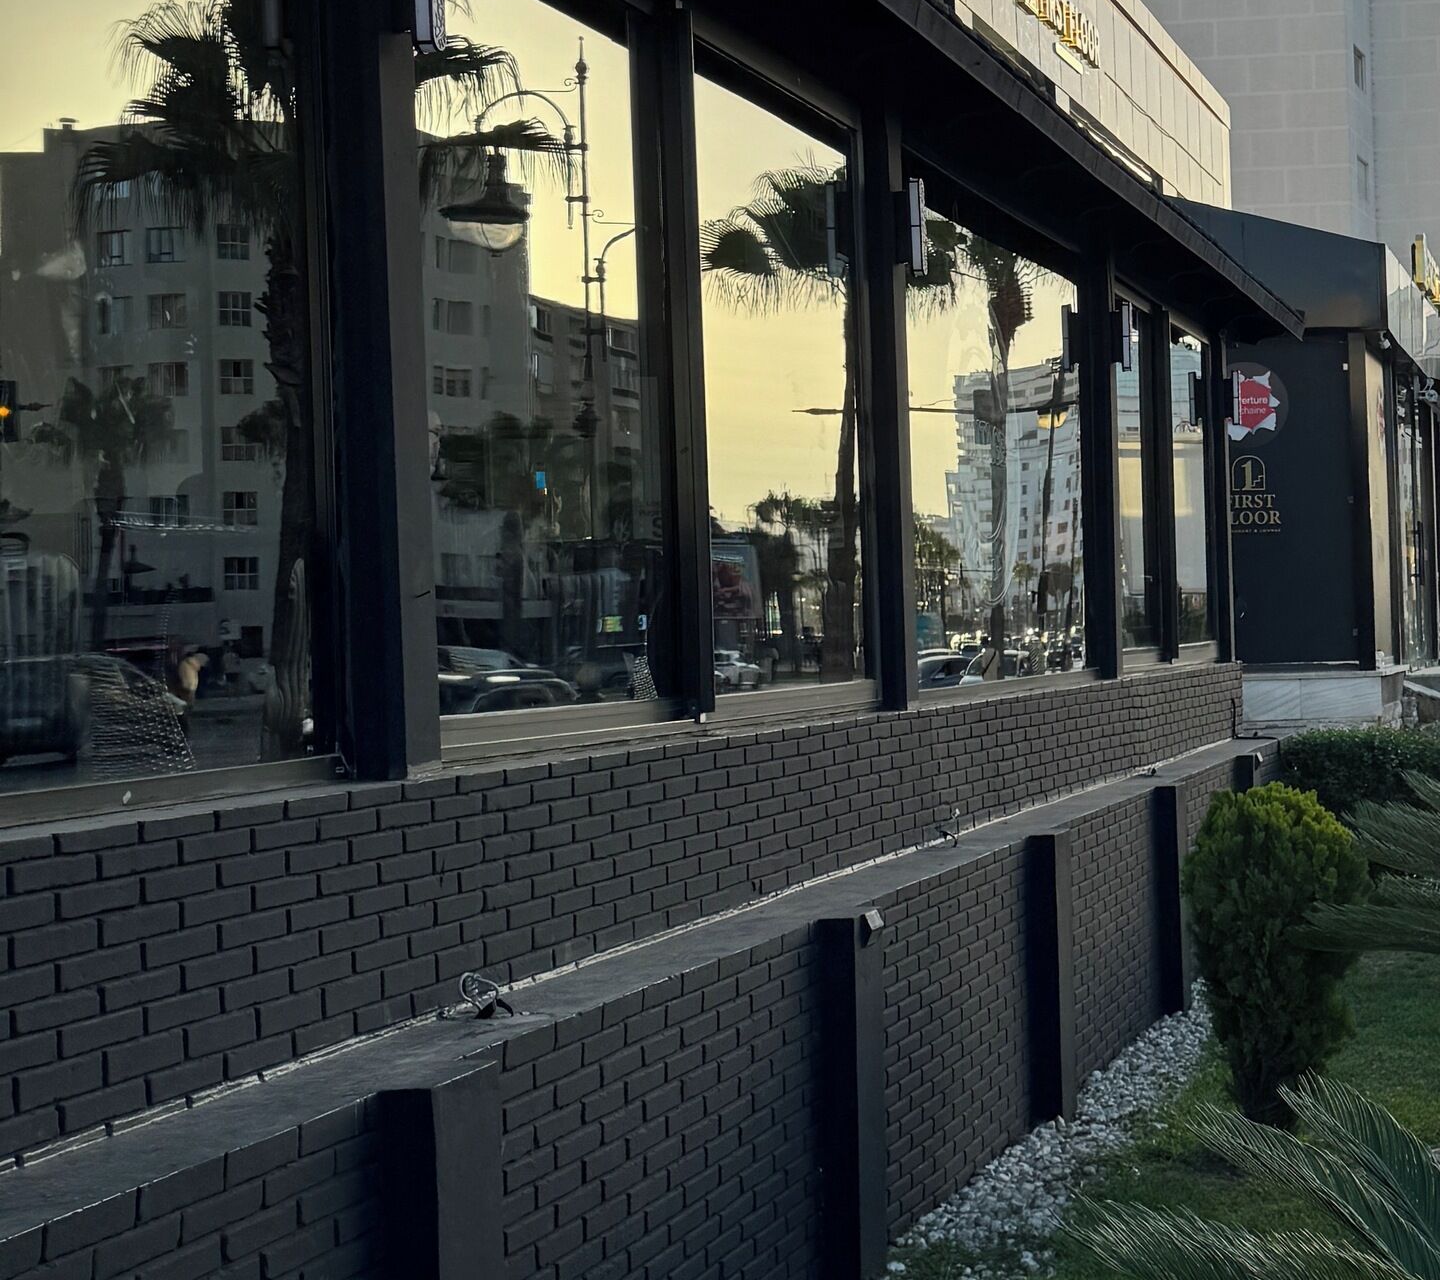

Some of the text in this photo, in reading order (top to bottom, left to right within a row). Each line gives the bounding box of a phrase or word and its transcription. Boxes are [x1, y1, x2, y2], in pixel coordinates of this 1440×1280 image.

[1068, 2, 1100, 67] FLOOR
[1241, 396, 1268, 405] erture
[1241, 406, 1266, 414] chaine
[1241, 460, 1252, 491] 1
[1231, 510, 1282, 525] LOOR
